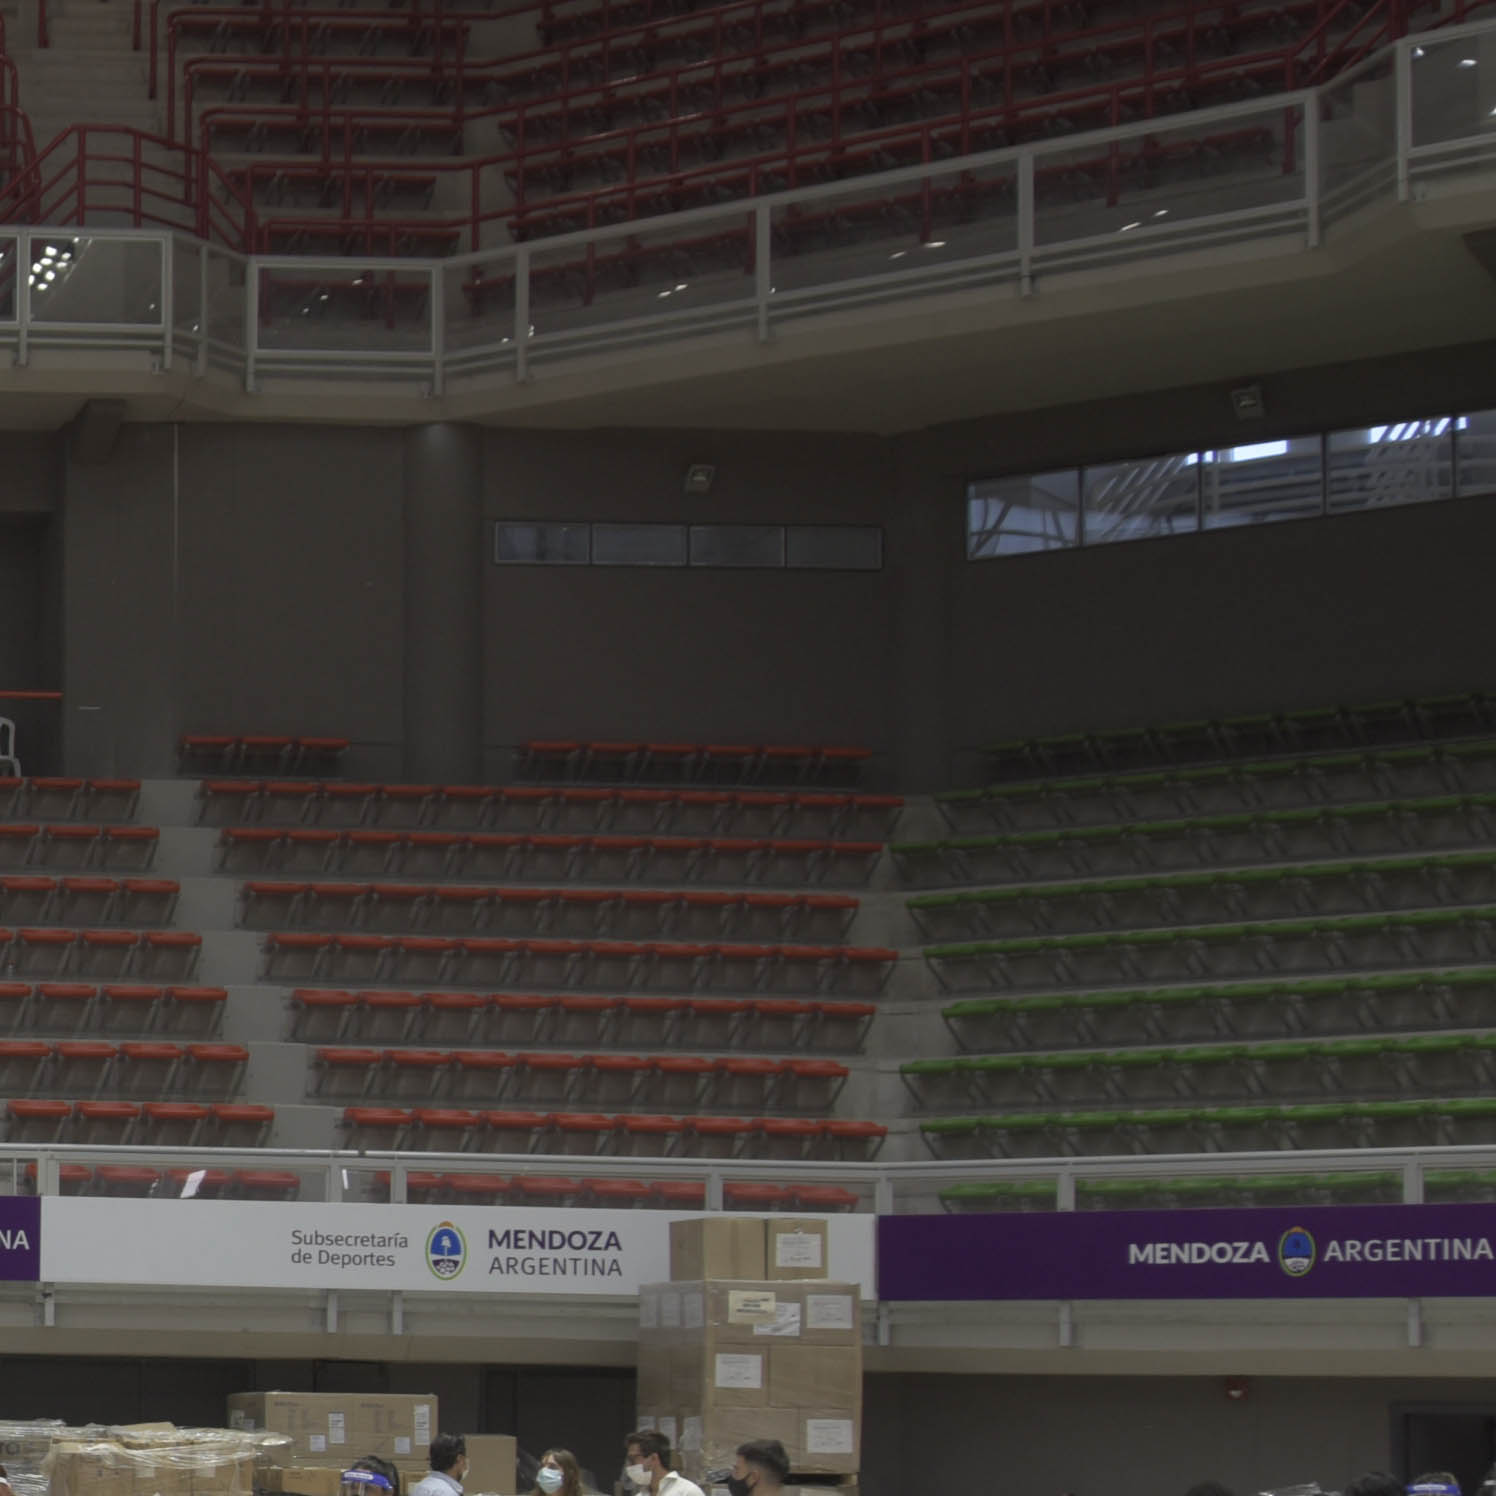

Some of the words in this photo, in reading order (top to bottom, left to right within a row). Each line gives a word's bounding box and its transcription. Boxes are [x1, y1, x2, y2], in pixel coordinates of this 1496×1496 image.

[291, 1229, 409, 1248] Subsecretaría
[489, 1230, 623, 1251] MENDOZA
[291, 1248, 312, 1265] de
[319, 1250, 396, 1269] Deportes
[1132, 1242, 1271, 1265] MENDOZA
[1324, 1237, 1494, 1262] ARGENTINA
[489, 1256, 623, 1277] ARGENTINA
